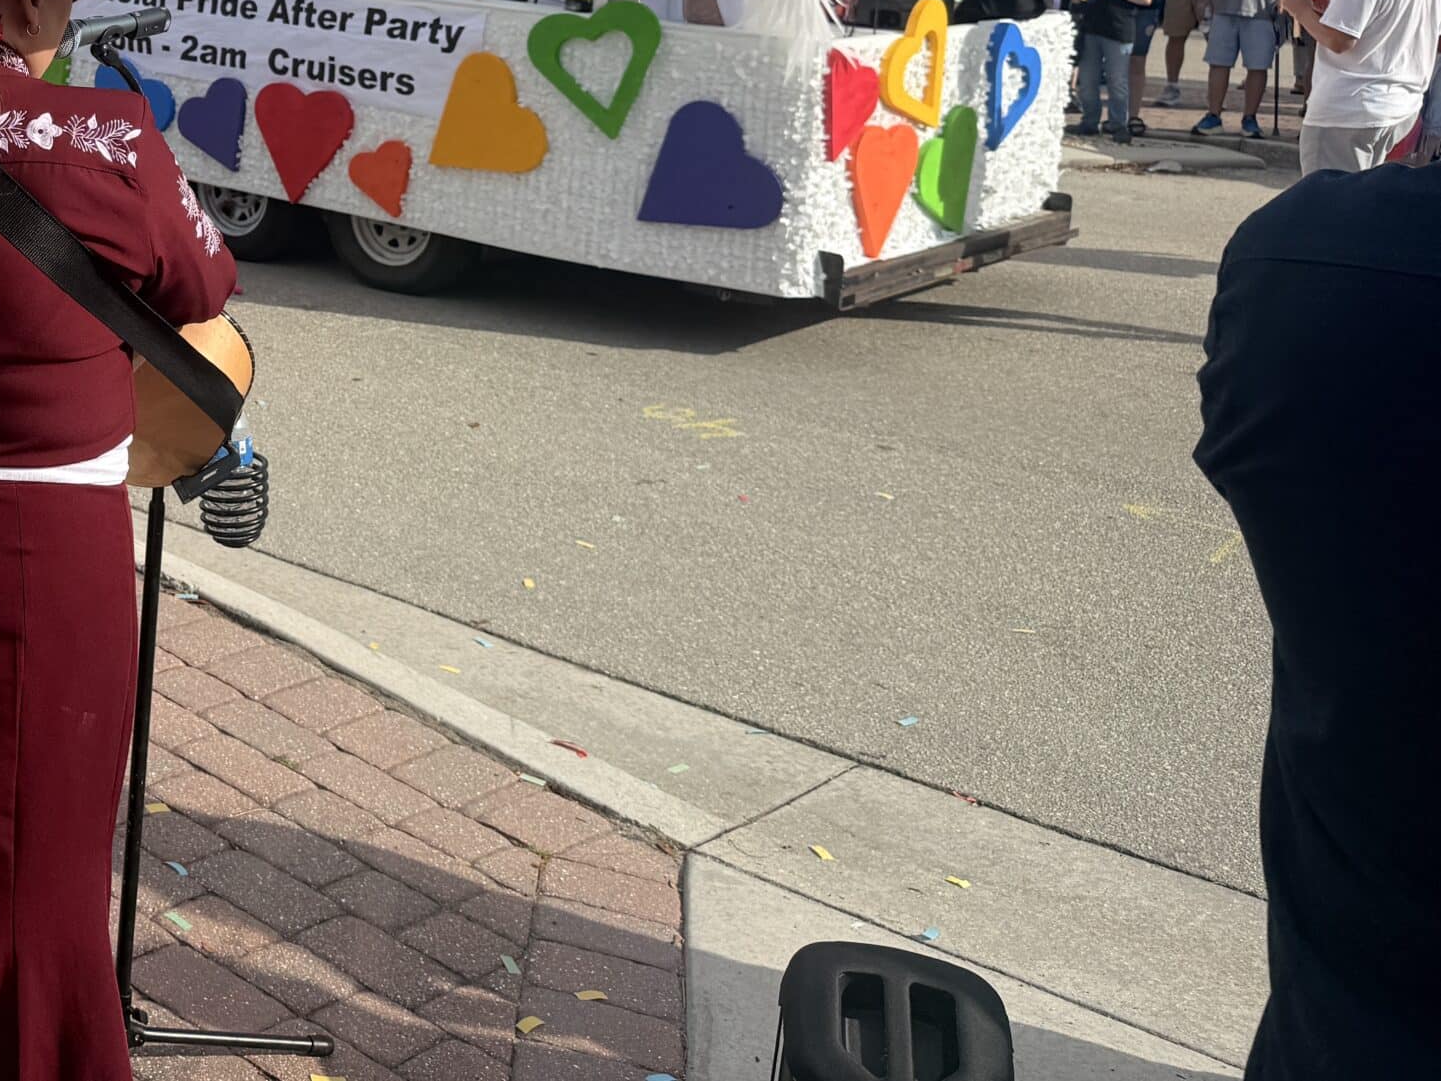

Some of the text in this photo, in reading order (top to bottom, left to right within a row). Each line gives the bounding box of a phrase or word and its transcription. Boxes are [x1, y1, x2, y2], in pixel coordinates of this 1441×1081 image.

[363, 7, 465, 54] Party
[180, 35, 247, 69] 2am
[268, 47, 416, 96] Cruisers
